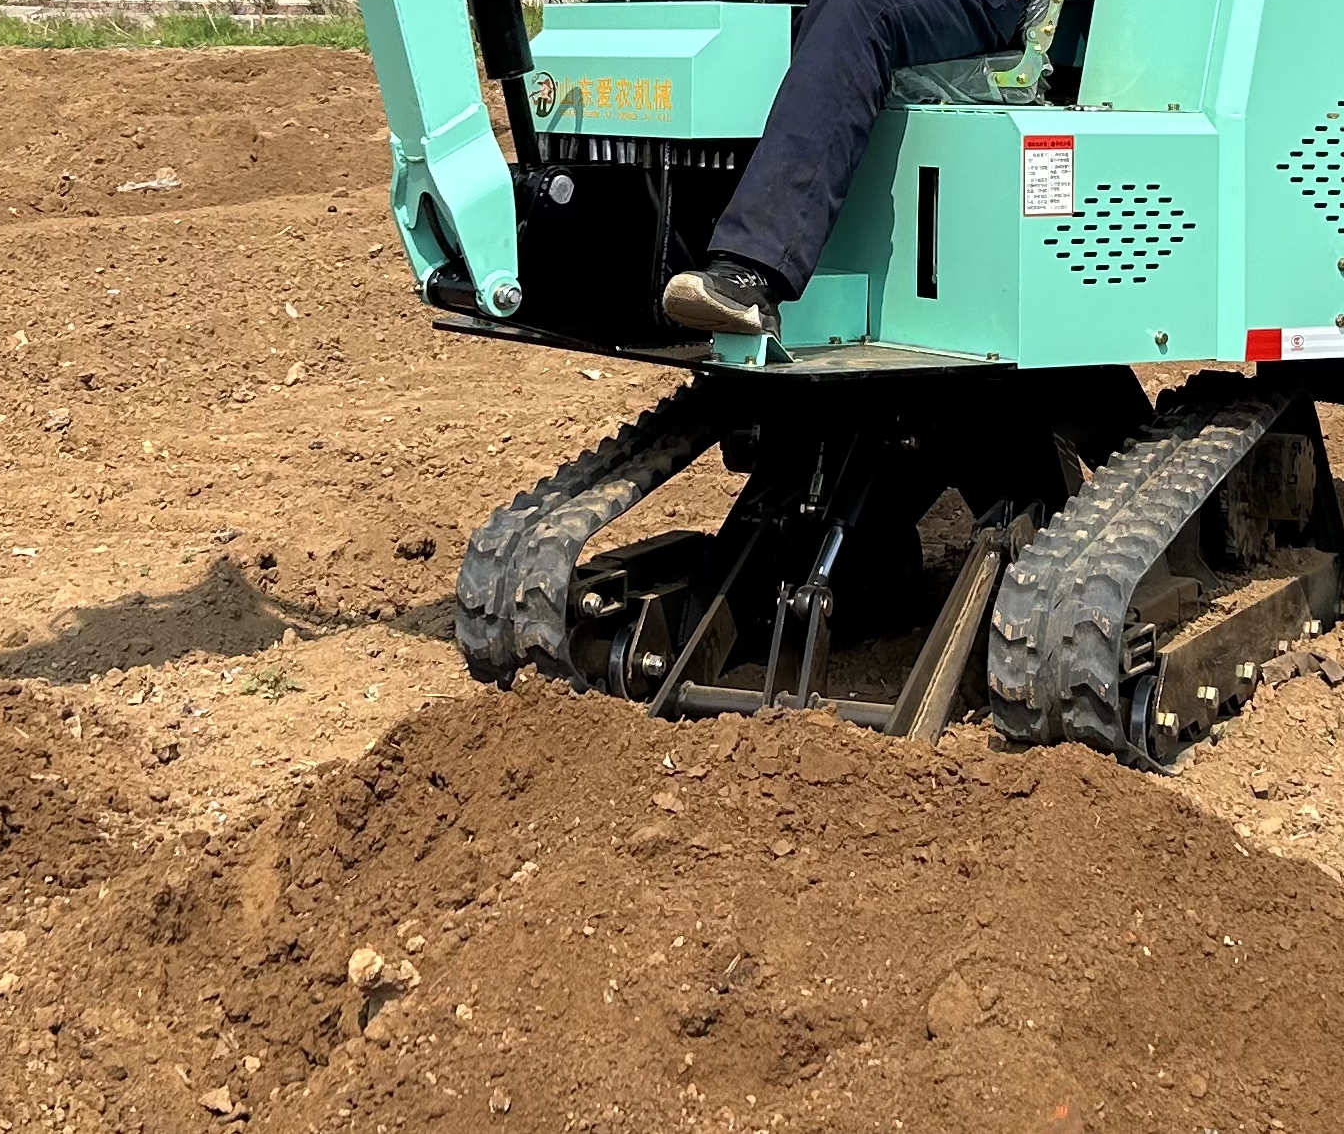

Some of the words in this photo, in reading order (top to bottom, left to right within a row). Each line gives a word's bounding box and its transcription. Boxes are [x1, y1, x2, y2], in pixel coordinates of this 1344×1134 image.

[559, 76, 672, 110] 山东爱农机械
